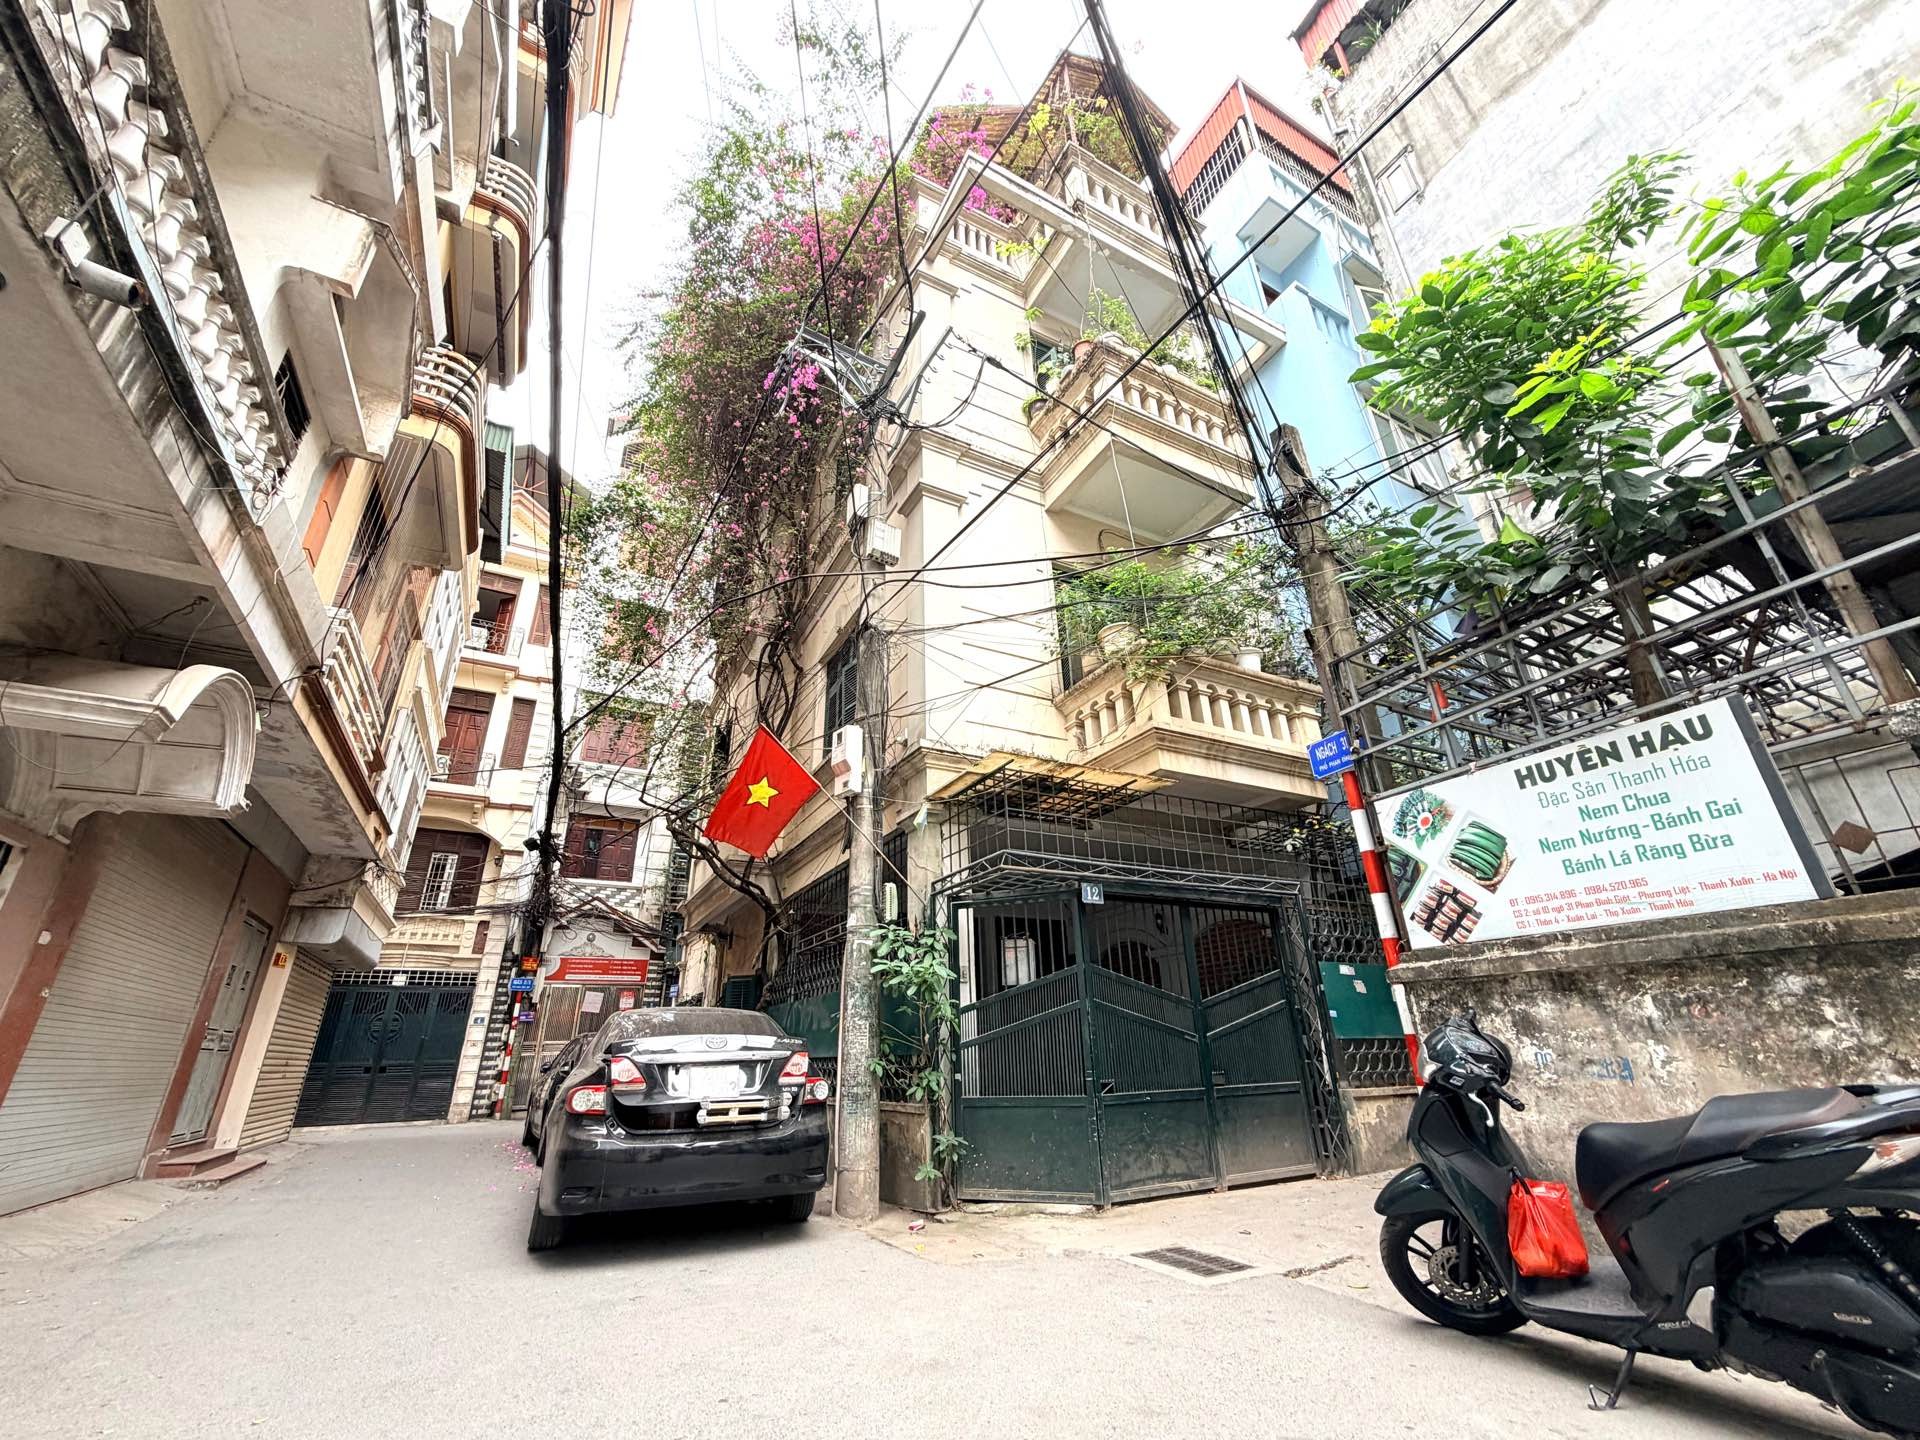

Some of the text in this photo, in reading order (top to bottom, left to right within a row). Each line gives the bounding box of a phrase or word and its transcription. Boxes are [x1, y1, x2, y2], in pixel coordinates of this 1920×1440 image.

[1315, 740, 1338, 761] NGÁCH
[1627, 713, 1714, 758] HẬU
[1329, 759, 1341, 768] PHAN
[1537, 753, 1712, 809] Đặc Sản Thanh Hóa
[1538, 837, 1577, 854] Nem
[1705, 797, 1744, 820] Gai
[1577, 791, 1671, 823] Nem Chua
[1561, 833, 1735, 876] Bánh Lá Răng Bừa
[1086, 886, 1100, 900] 12
[1565, 902, 1574, 911] 31
[1575, 899, 1594, 909] Phan
[1638, 889, 1673, 901] Phương
[1673, 883, 1691, 897] Liệt
[1698, 878, 1728, 892] Thanh
[1728, 874, 1754, 887] Xuân
[1778, 868, 1798, 880] Nội
[1535, 917, 1553, 927] Thôn
[1619, 904, 1642, 915] Xuân
[1648, 900, 1675, 911] Thanh
[1675, 897, 1695, 908] Hóa
